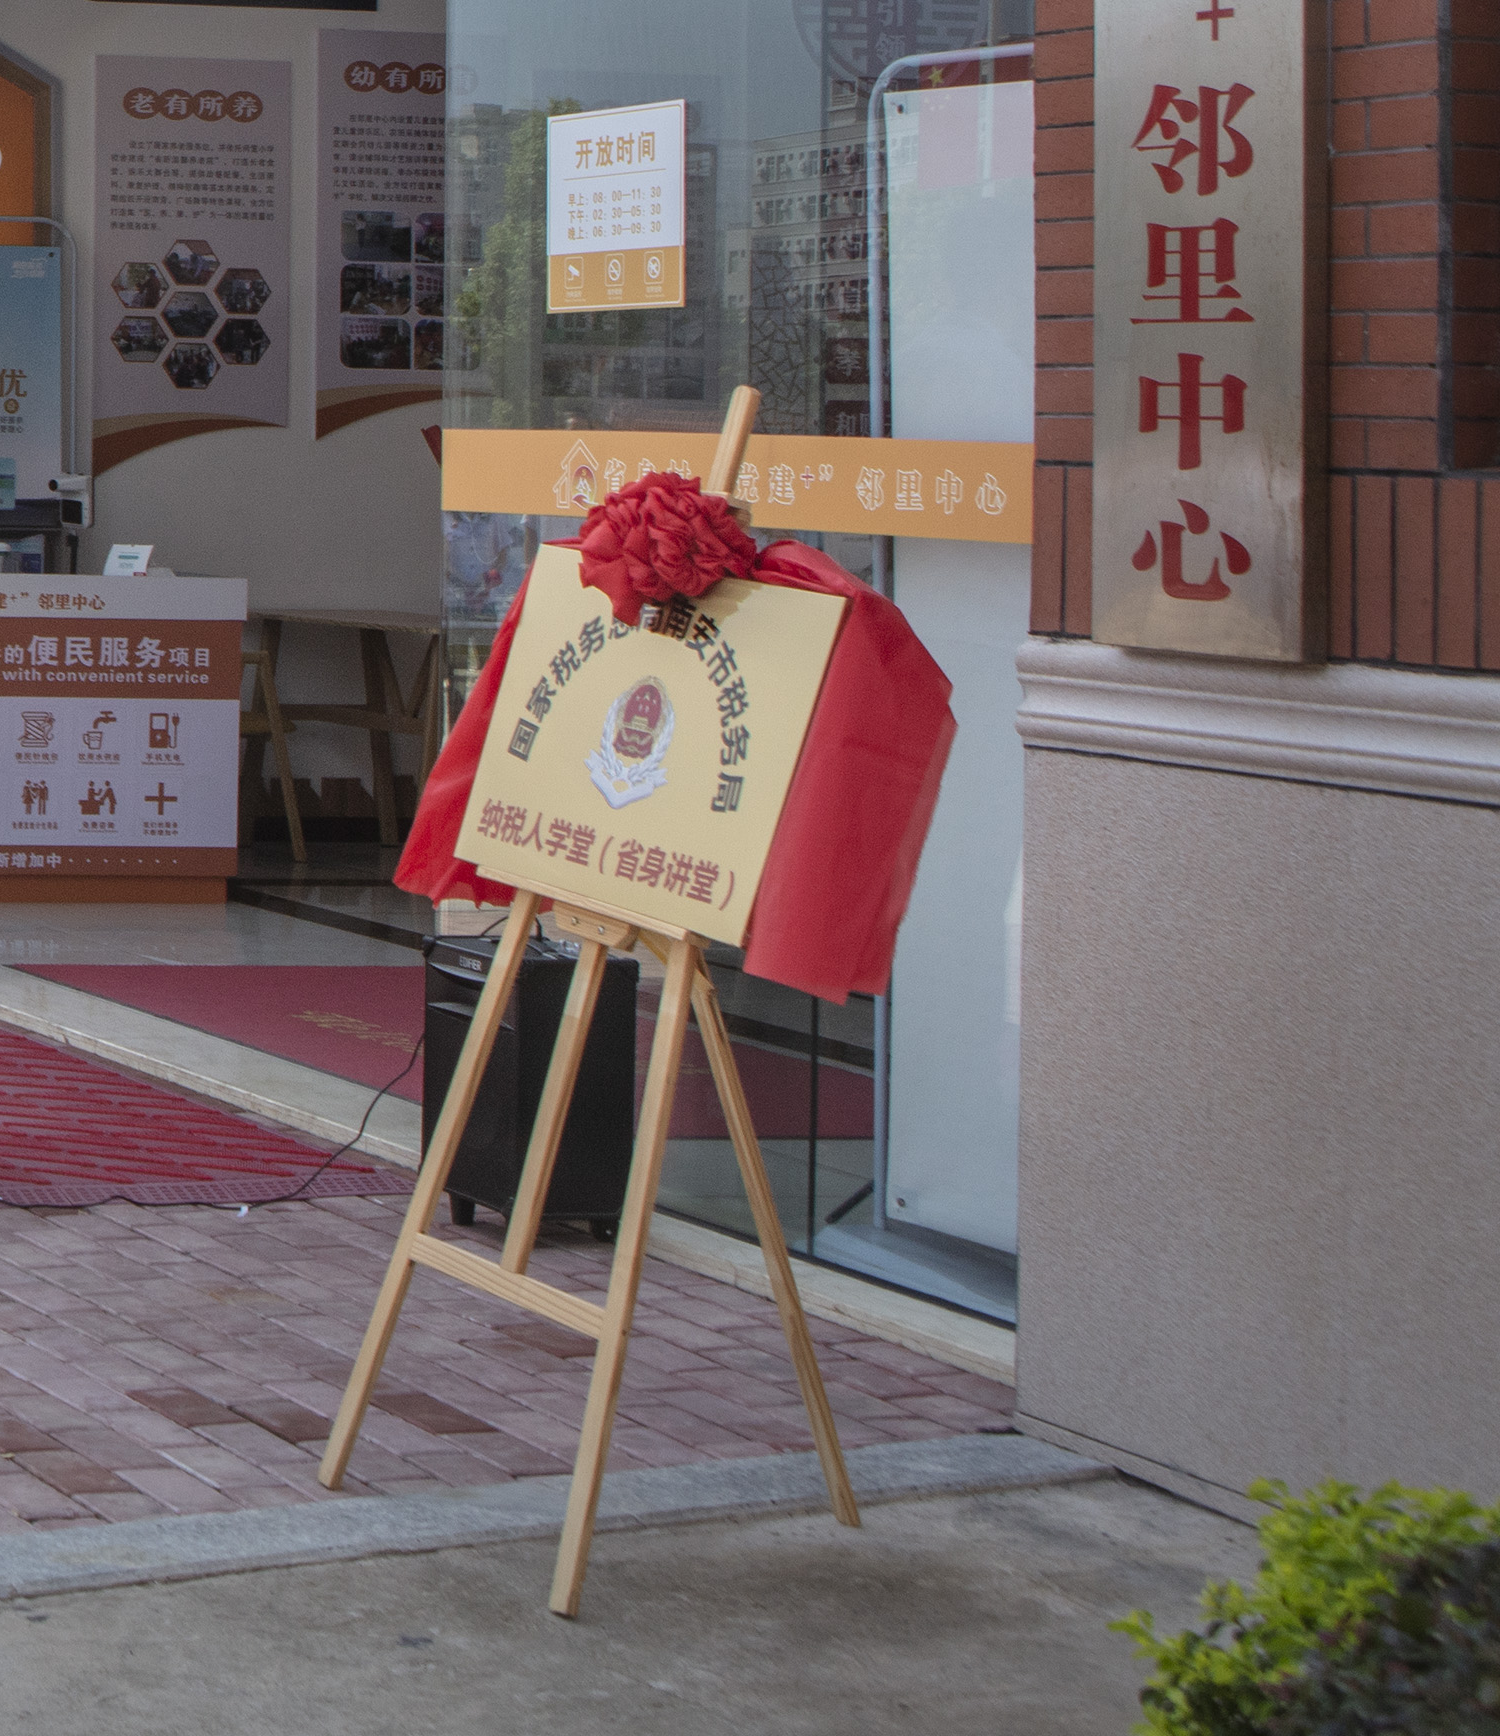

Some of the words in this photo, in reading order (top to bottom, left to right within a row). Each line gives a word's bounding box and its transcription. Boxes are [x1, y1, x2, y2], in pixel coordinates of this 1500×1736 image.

[129, 92, 260, 119] 老有所养
[575, 131, 656, 169] 开放时间
[3, 668, 42, 682] with
[46, 669, 143, 684] convenient
[148, 670, 210, 684] service
[477, 797, 736, 911] 纳税人学堂（省身讲堂）
